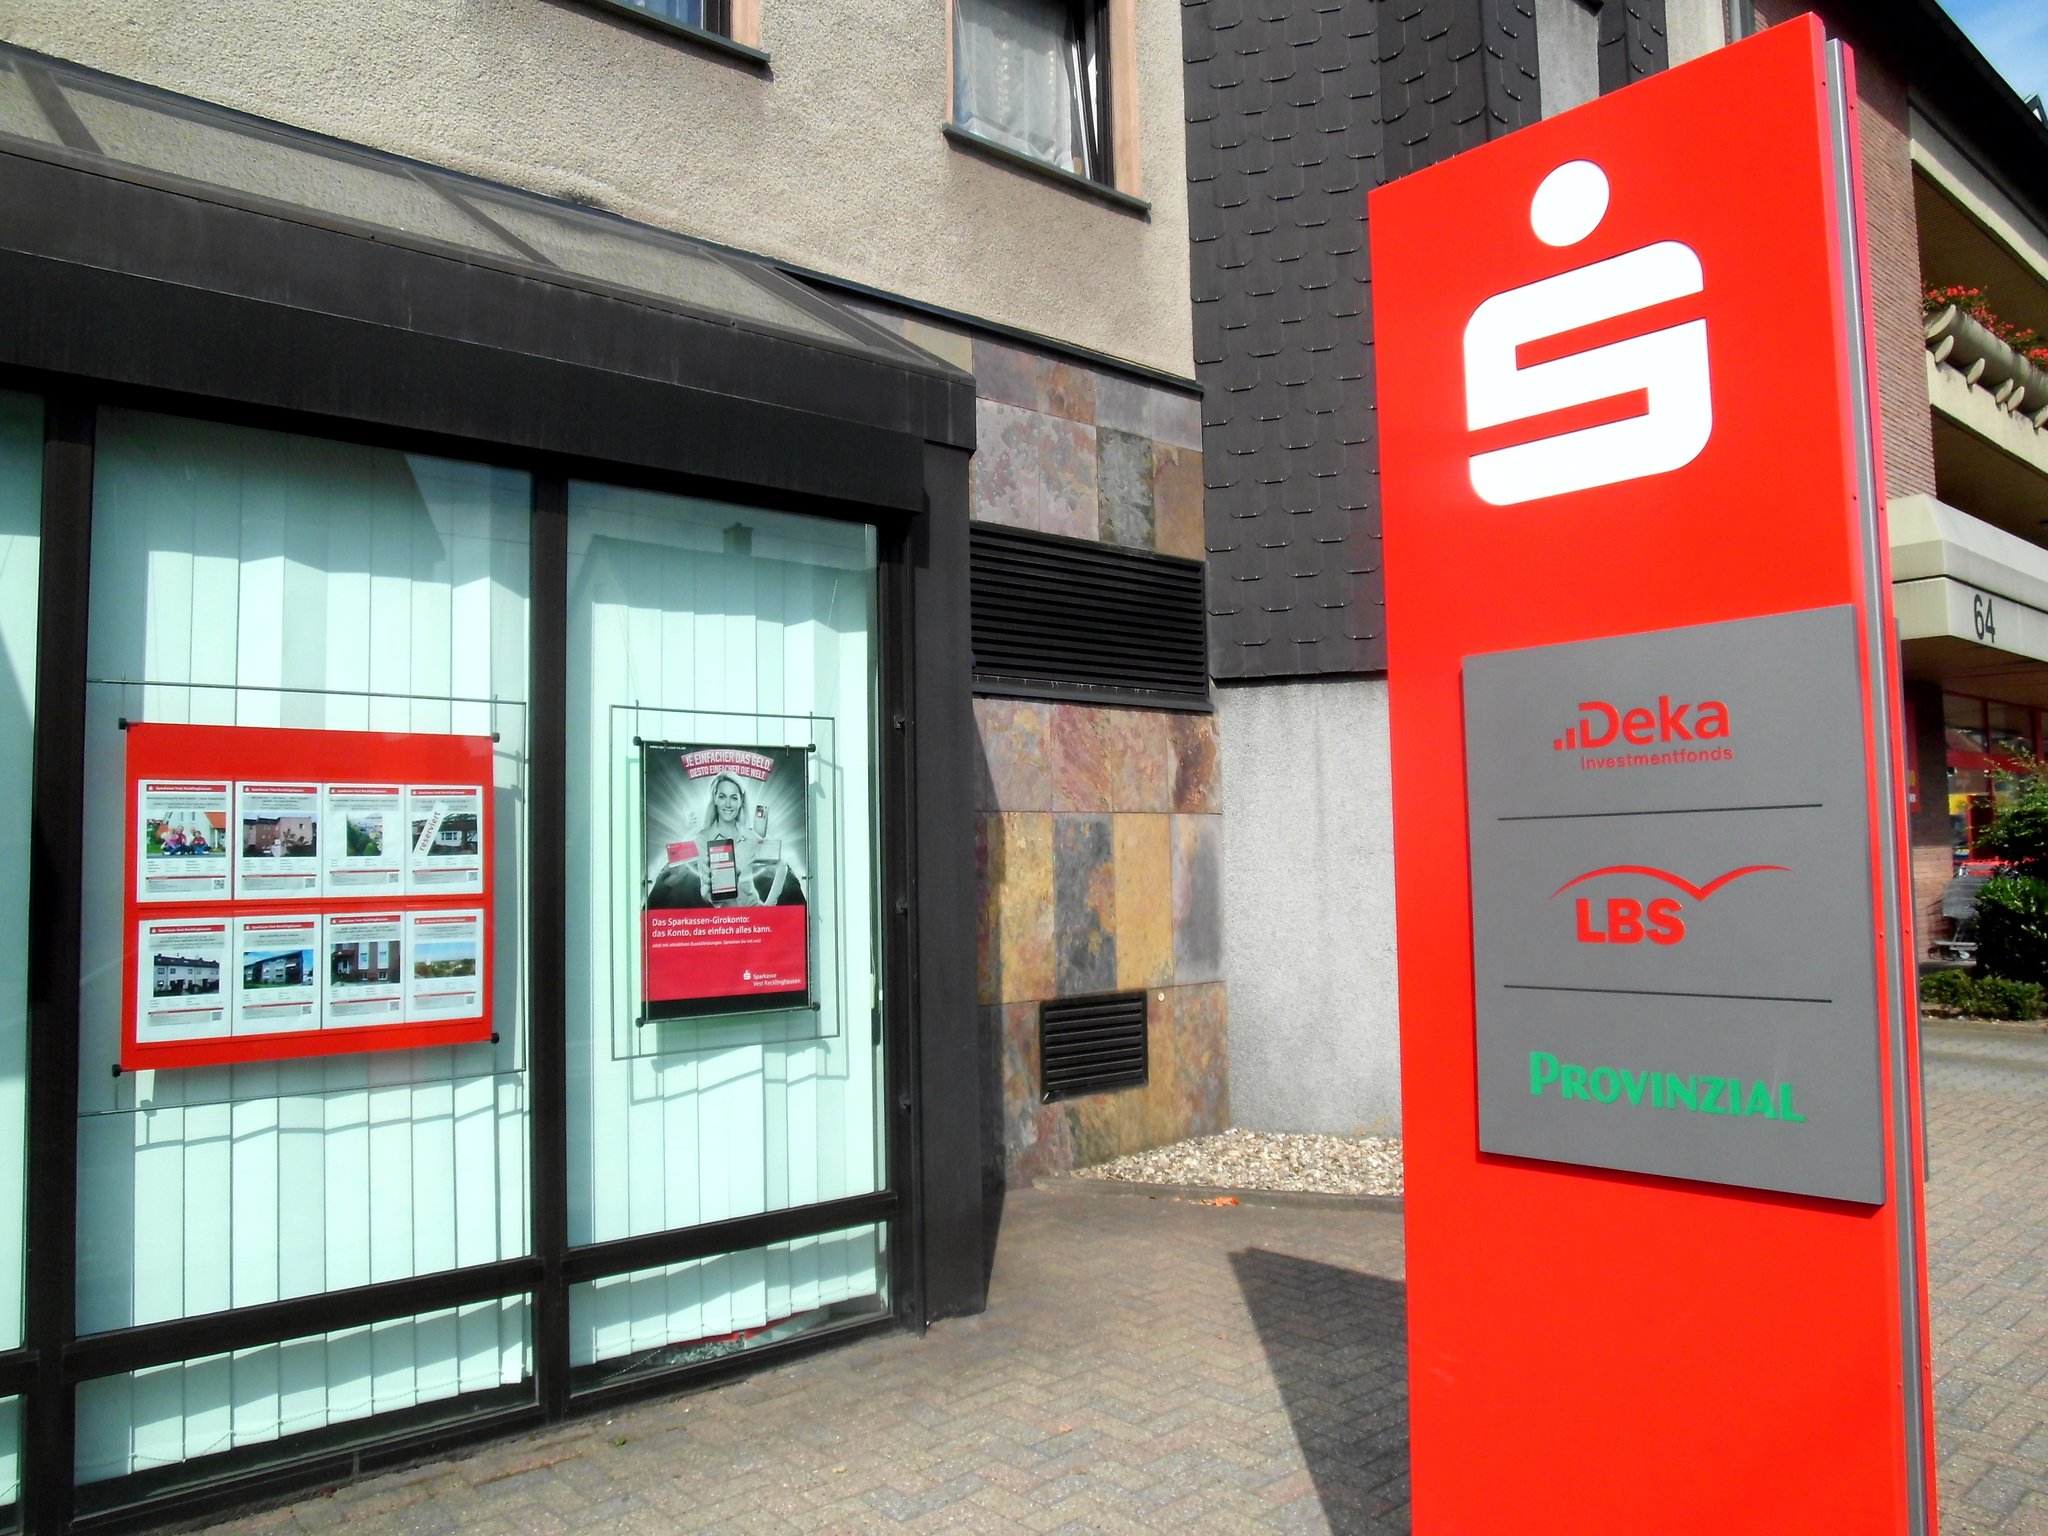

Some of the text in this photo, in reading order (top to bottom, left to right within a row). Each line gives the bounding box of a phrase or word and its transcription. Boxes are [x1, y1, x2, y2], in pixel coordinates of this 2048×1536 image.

[1974, 593, 1995, 643] 64
[1577, 695, 1731, 749] Deka
[685, 755, 695, 768] JE
[695, 751, 734, 765] EINFACHER
[735, 753, 751, 765] DAS
[1580, 746, 1734, 770] Investmentfonds
[419, 811, 441, 851] reserviert
[652, 915, 750, 928] Das Sparkassen-Girokonto:
[652, 924, 772, 938] das Konto, das einfach alles kann.
[1576, 897, 1687, 946] LBS
[753, 973, 777, 981] Sparkasse
[1530, 1051, 1808, 1123] PROVINZIAL
